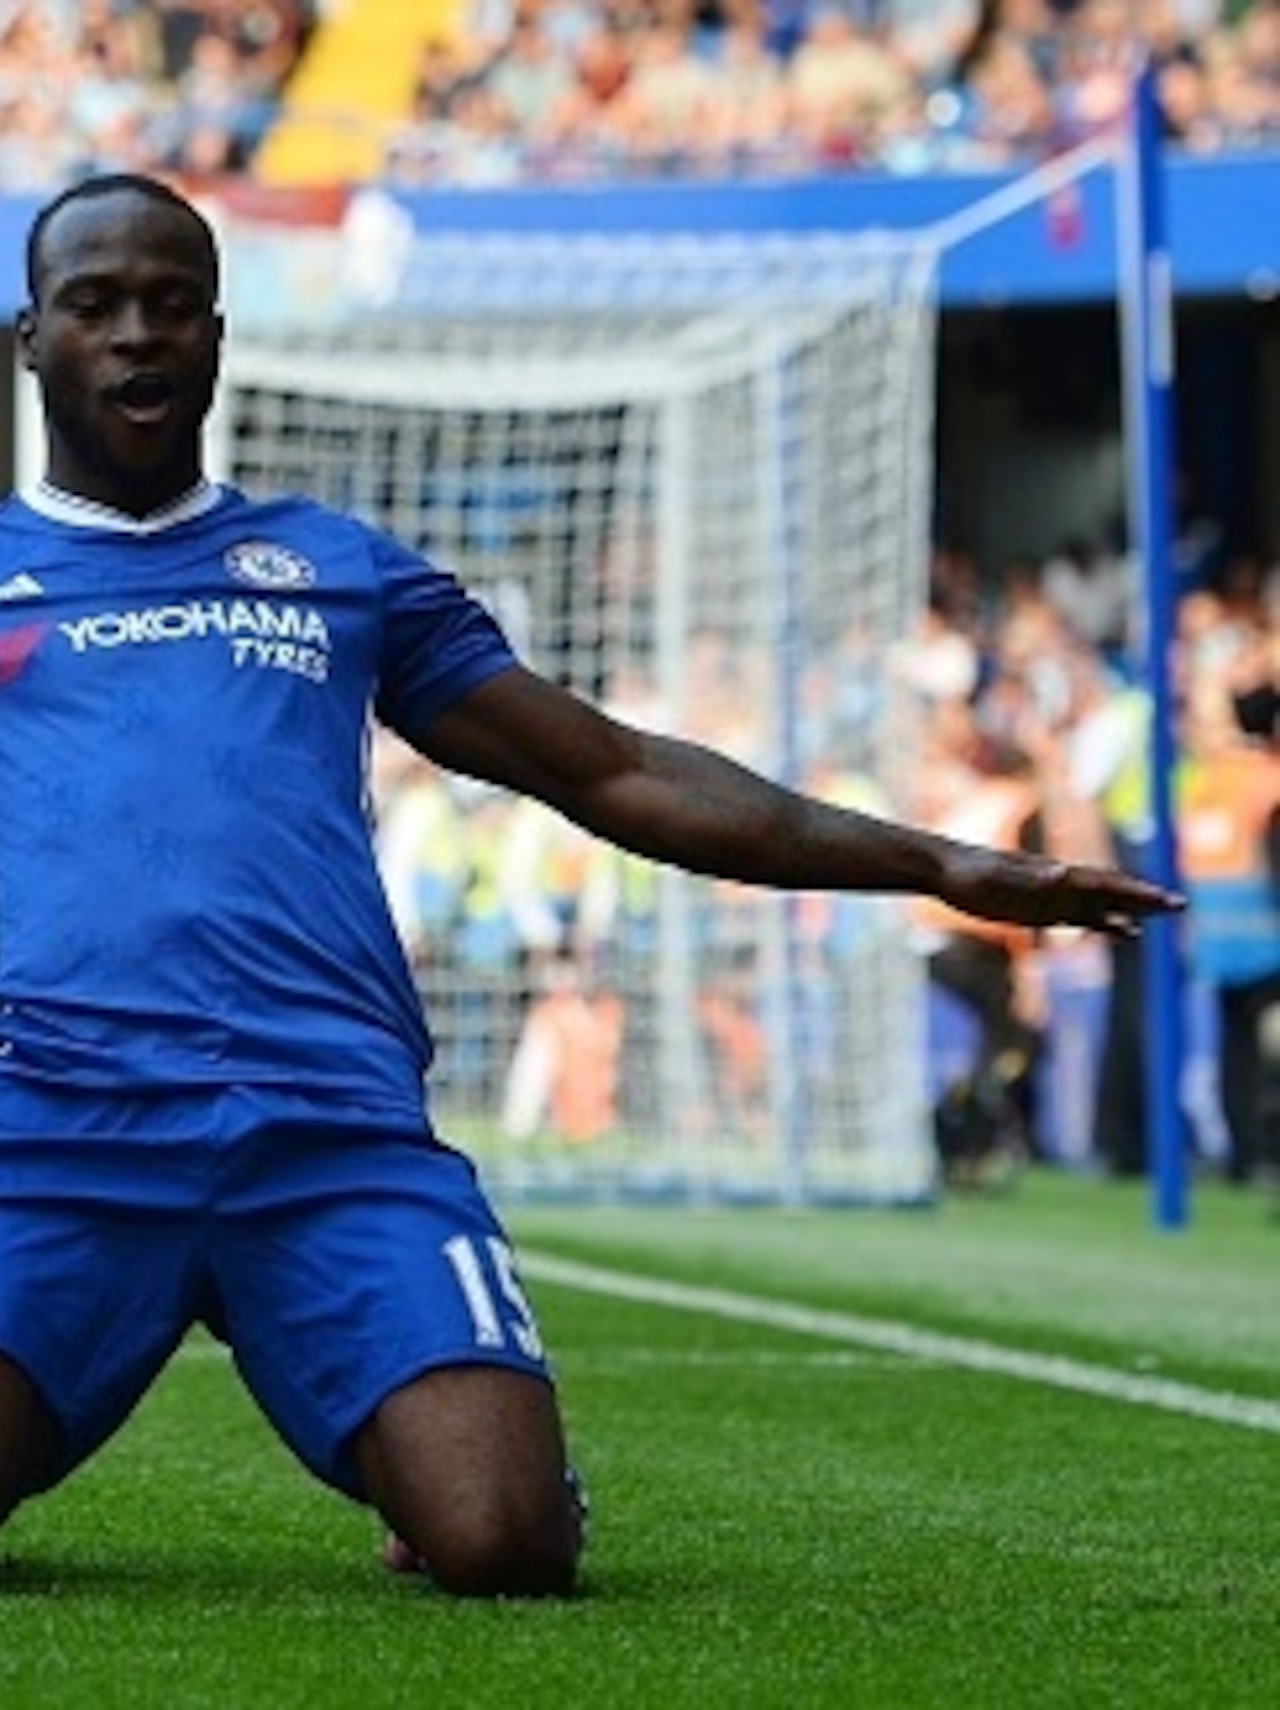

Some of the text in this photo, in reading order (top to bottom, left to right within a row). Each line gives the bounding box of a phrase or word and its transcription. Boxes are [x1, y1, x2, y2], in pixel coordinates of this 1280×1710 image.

[58, 599, 330, 652] YOKOHAMA
[230, 637, 328, 684] TYRES
[441, 1234, 543, 1361] 15
